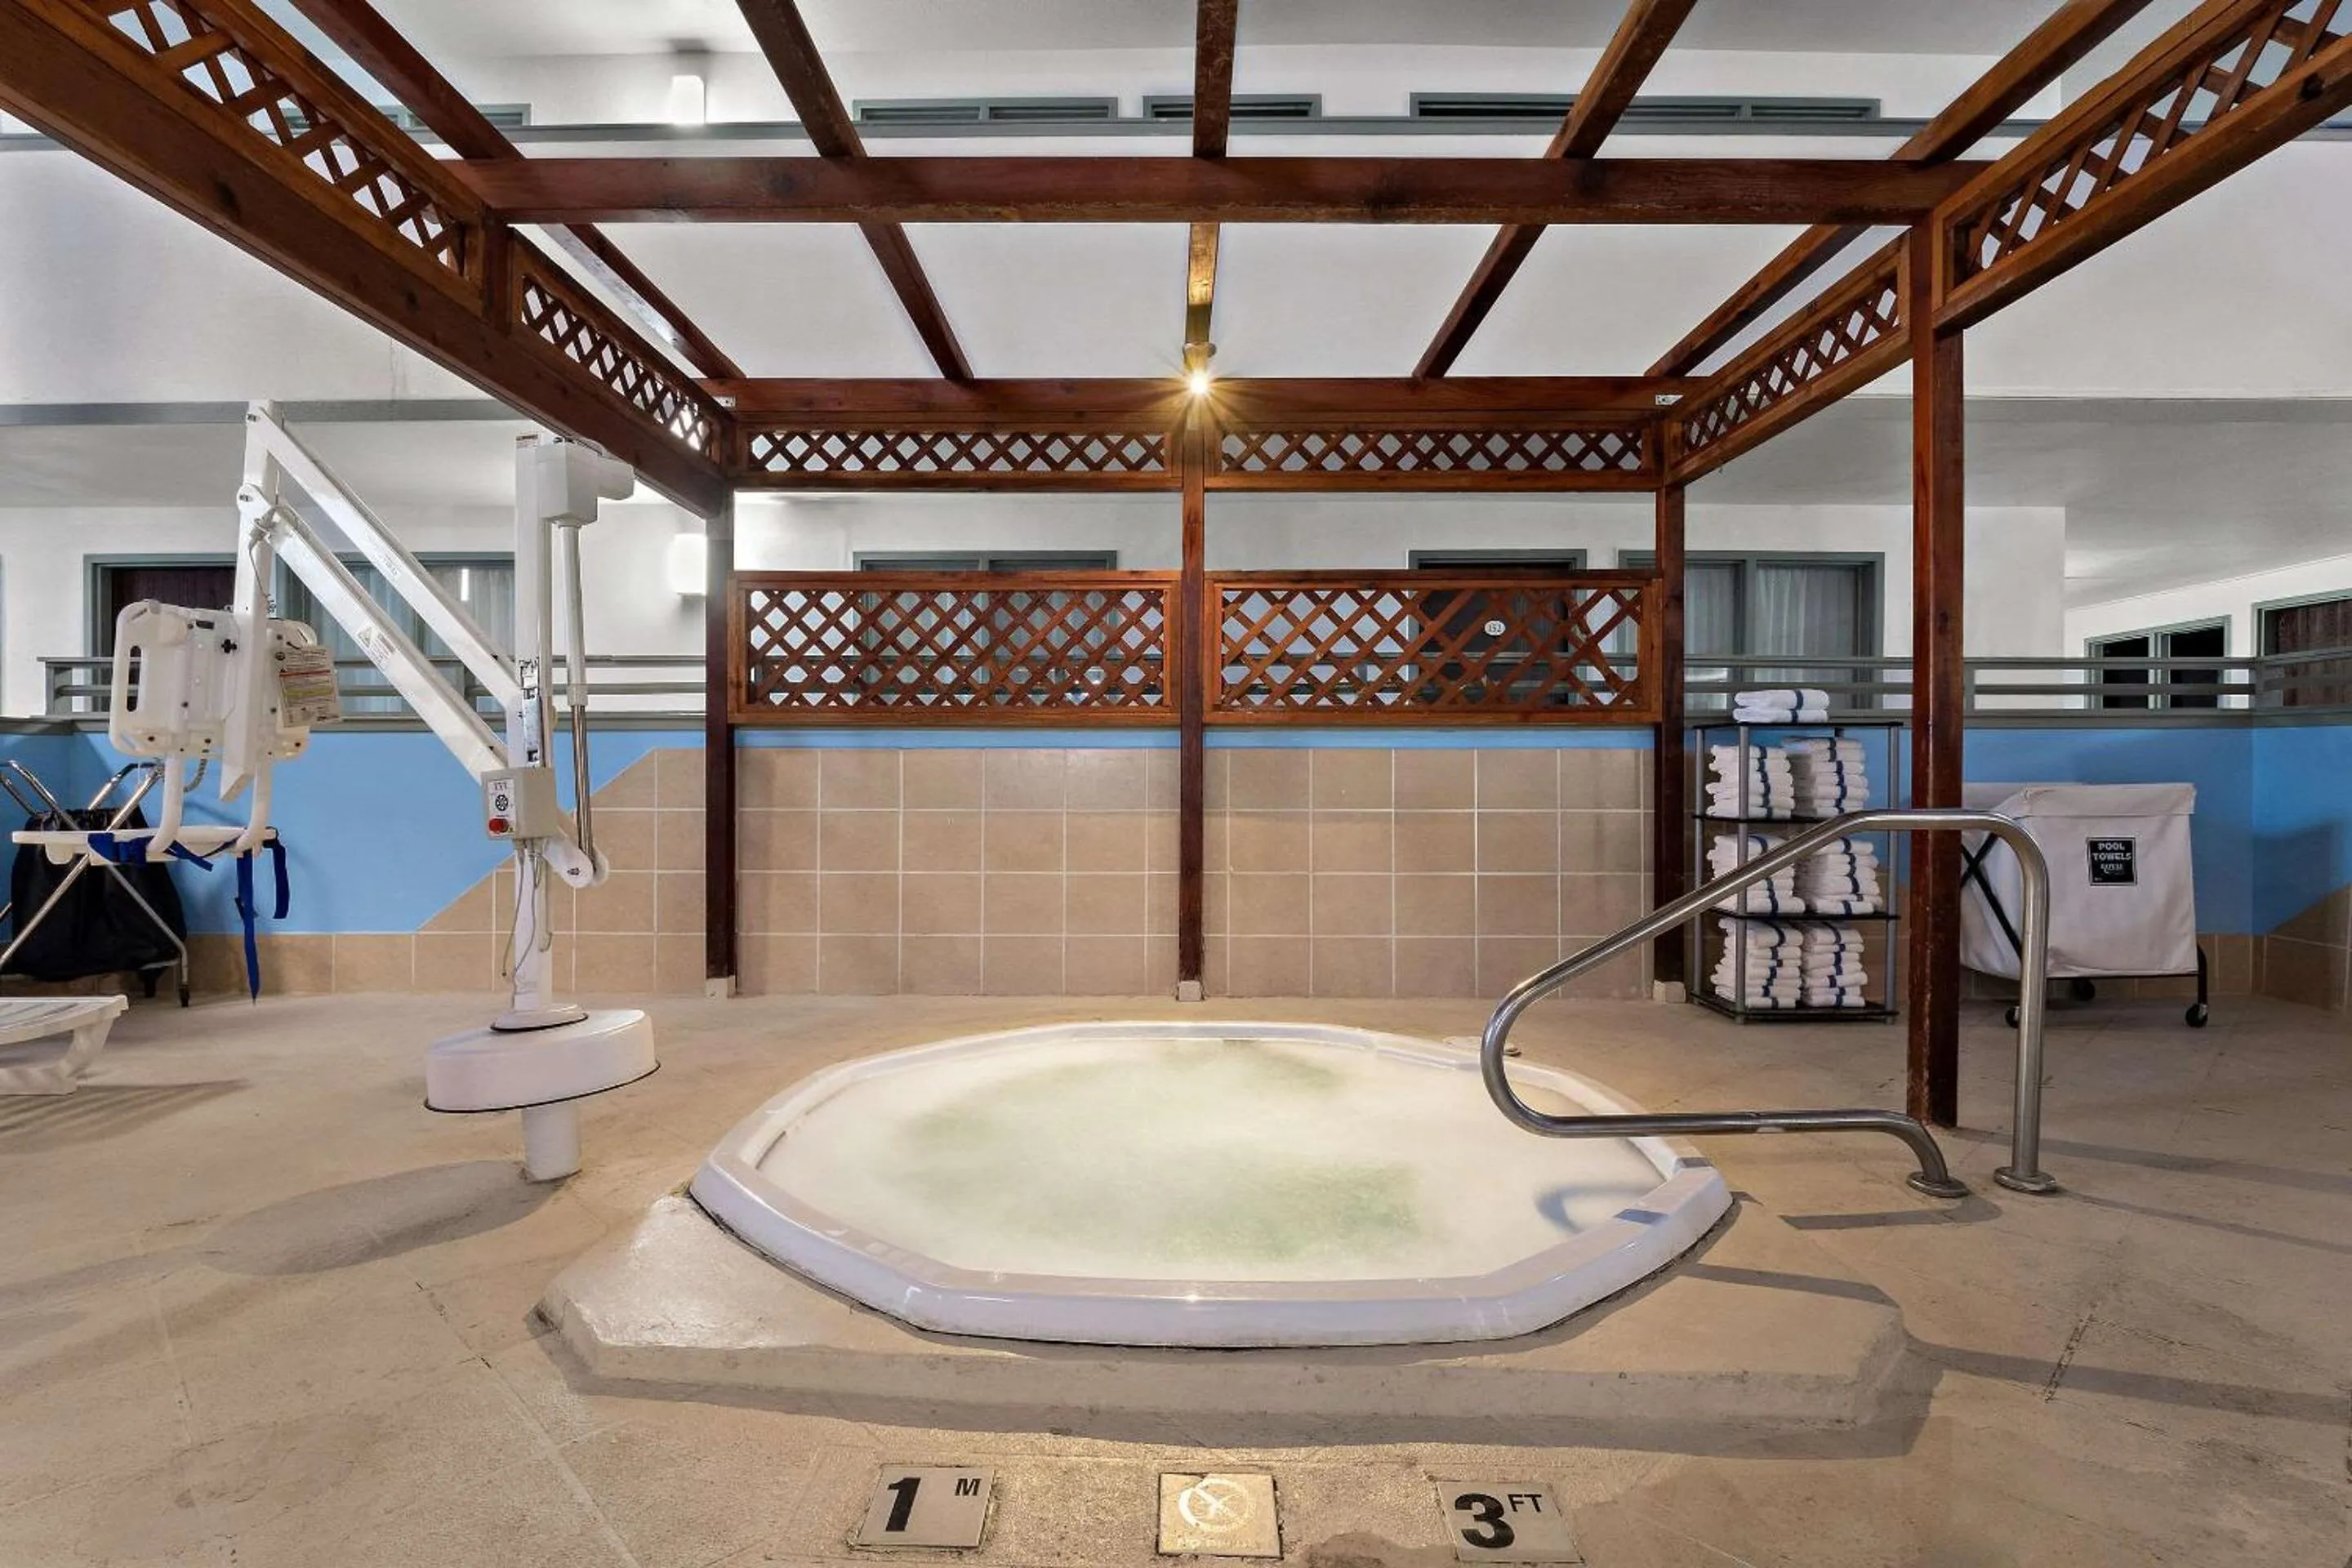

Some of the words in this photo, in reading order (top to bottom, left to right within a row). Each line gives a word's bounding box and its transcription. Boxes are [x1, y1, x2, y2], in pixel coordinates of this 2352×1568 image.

[2091, 852, 2132, 860] TOWELS
[2097, 842, 2125, 850] POOL
[885, 1477, 921, 1532] 1
[955, 1478, 982, 1496] M
[1454, 1493, 1515, 1548] 3
[1508, 1494, 1542, 1512] FT
